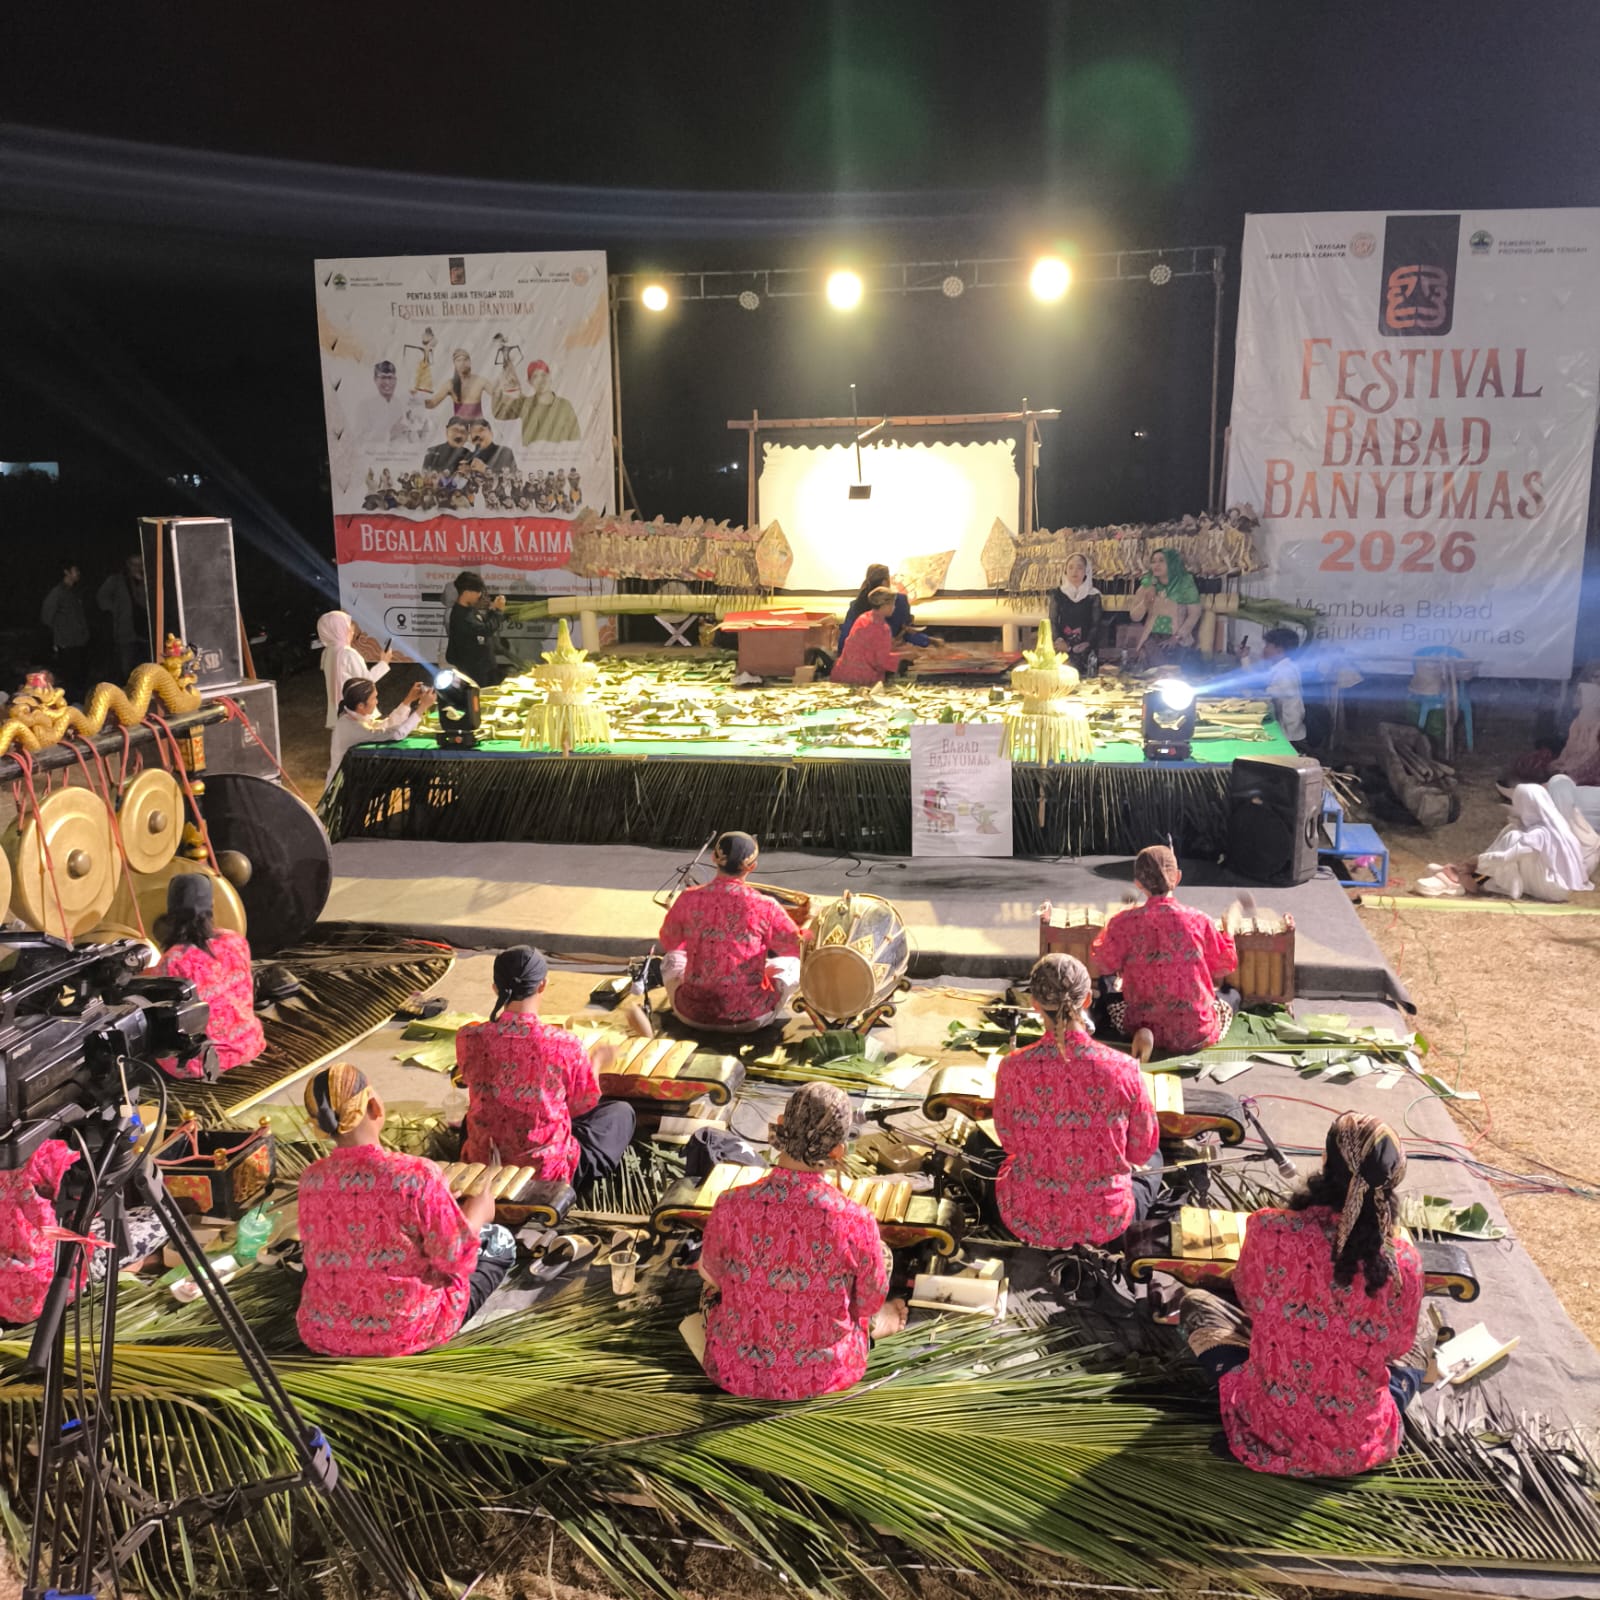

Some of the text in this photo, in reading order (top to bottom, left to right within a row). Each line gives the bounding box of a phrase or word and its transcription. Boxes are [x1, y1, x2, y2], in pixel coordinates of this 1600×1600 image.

[391, 302, 436, 320] FESTIVAL
[442, 301, 475, 317] BABAD
[1300, 337, 1543, 414] FESTIVAL
[1322, 405, 1491, 467] BABAD
[1262, 459, 1546, 521] BANYUMAS
[360, 524, 574, 555] BEGALAN JAKA KAIMA
[1318, 530, 1477, 573] 2026
[1296, 598, 1493, 619] Membuka Babad
[1402, 623, 1525, 645] Banyumas
[942, 739, 979, 754] BABAD
[929, 752, 991, 769] BANYUMAS
